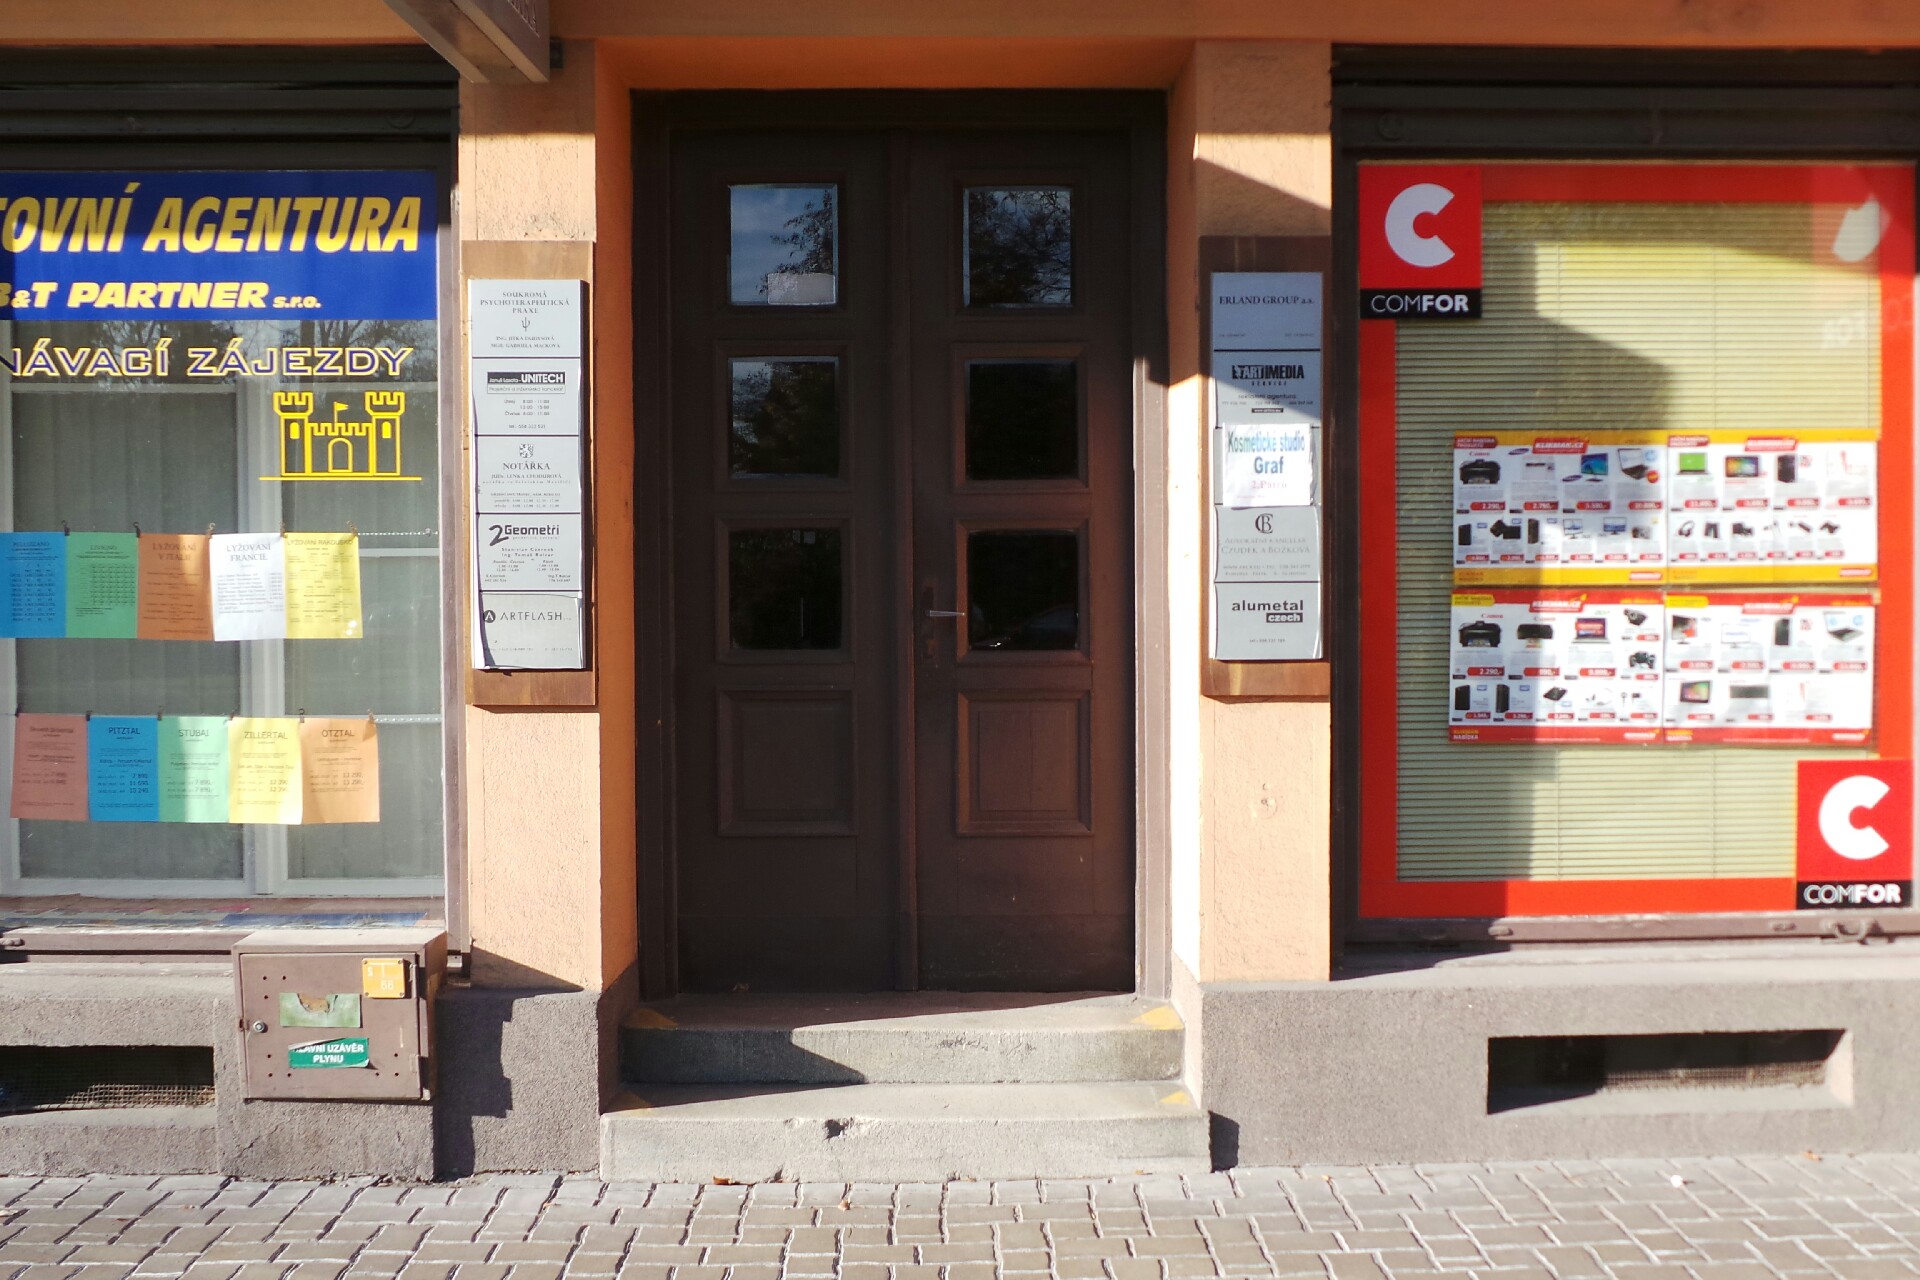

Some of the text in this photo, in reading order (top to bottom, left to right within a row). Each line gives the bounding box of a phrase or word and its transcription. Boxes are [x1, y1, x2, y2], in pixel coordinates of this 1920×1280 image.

[0, 181, 422, 254] OVNÍ AGENTURA
[68, 282, 270, 309] PARTNER
[273, 294, 321, 309] s.r.o.
[502, 290, 547, 298] SOUKROMÁ
[480, 297, 570, 306] PSYCHOTERAPEUTICKÁ
[1219, 296, 1261, 305] ERLAND
[1262, 296, 1299, 305] GROUP
[1371, 295, 1469, 312] COMFOR
[187, 337, 414, 377] ZÁJEZDY
[1280, 431, 1305, 452] studio
[503, 460, 551, 470] NOTÁŘKA
[1254, 456, 1284, 474] Graf
[488, 524, 509, 547] 2
[230, 553, 268, 562] FRANCIE
[1231, 600, 1304, 611] alumetal
[500, 611, 562, 621] ARTFLASH
[1268, 613, 1301, 622] czech
[108, 727, 141, 735] PITZTAL
[178, 729, 210, 737] STUBAI
[244, 731, 288, 740] ZILLERTAL
[1804, 883, 1902, 904] COMFOR
[327, 1042, 364, 1053] UZÁVĚR
[312, 1055, 344, 1063] PLYNU
